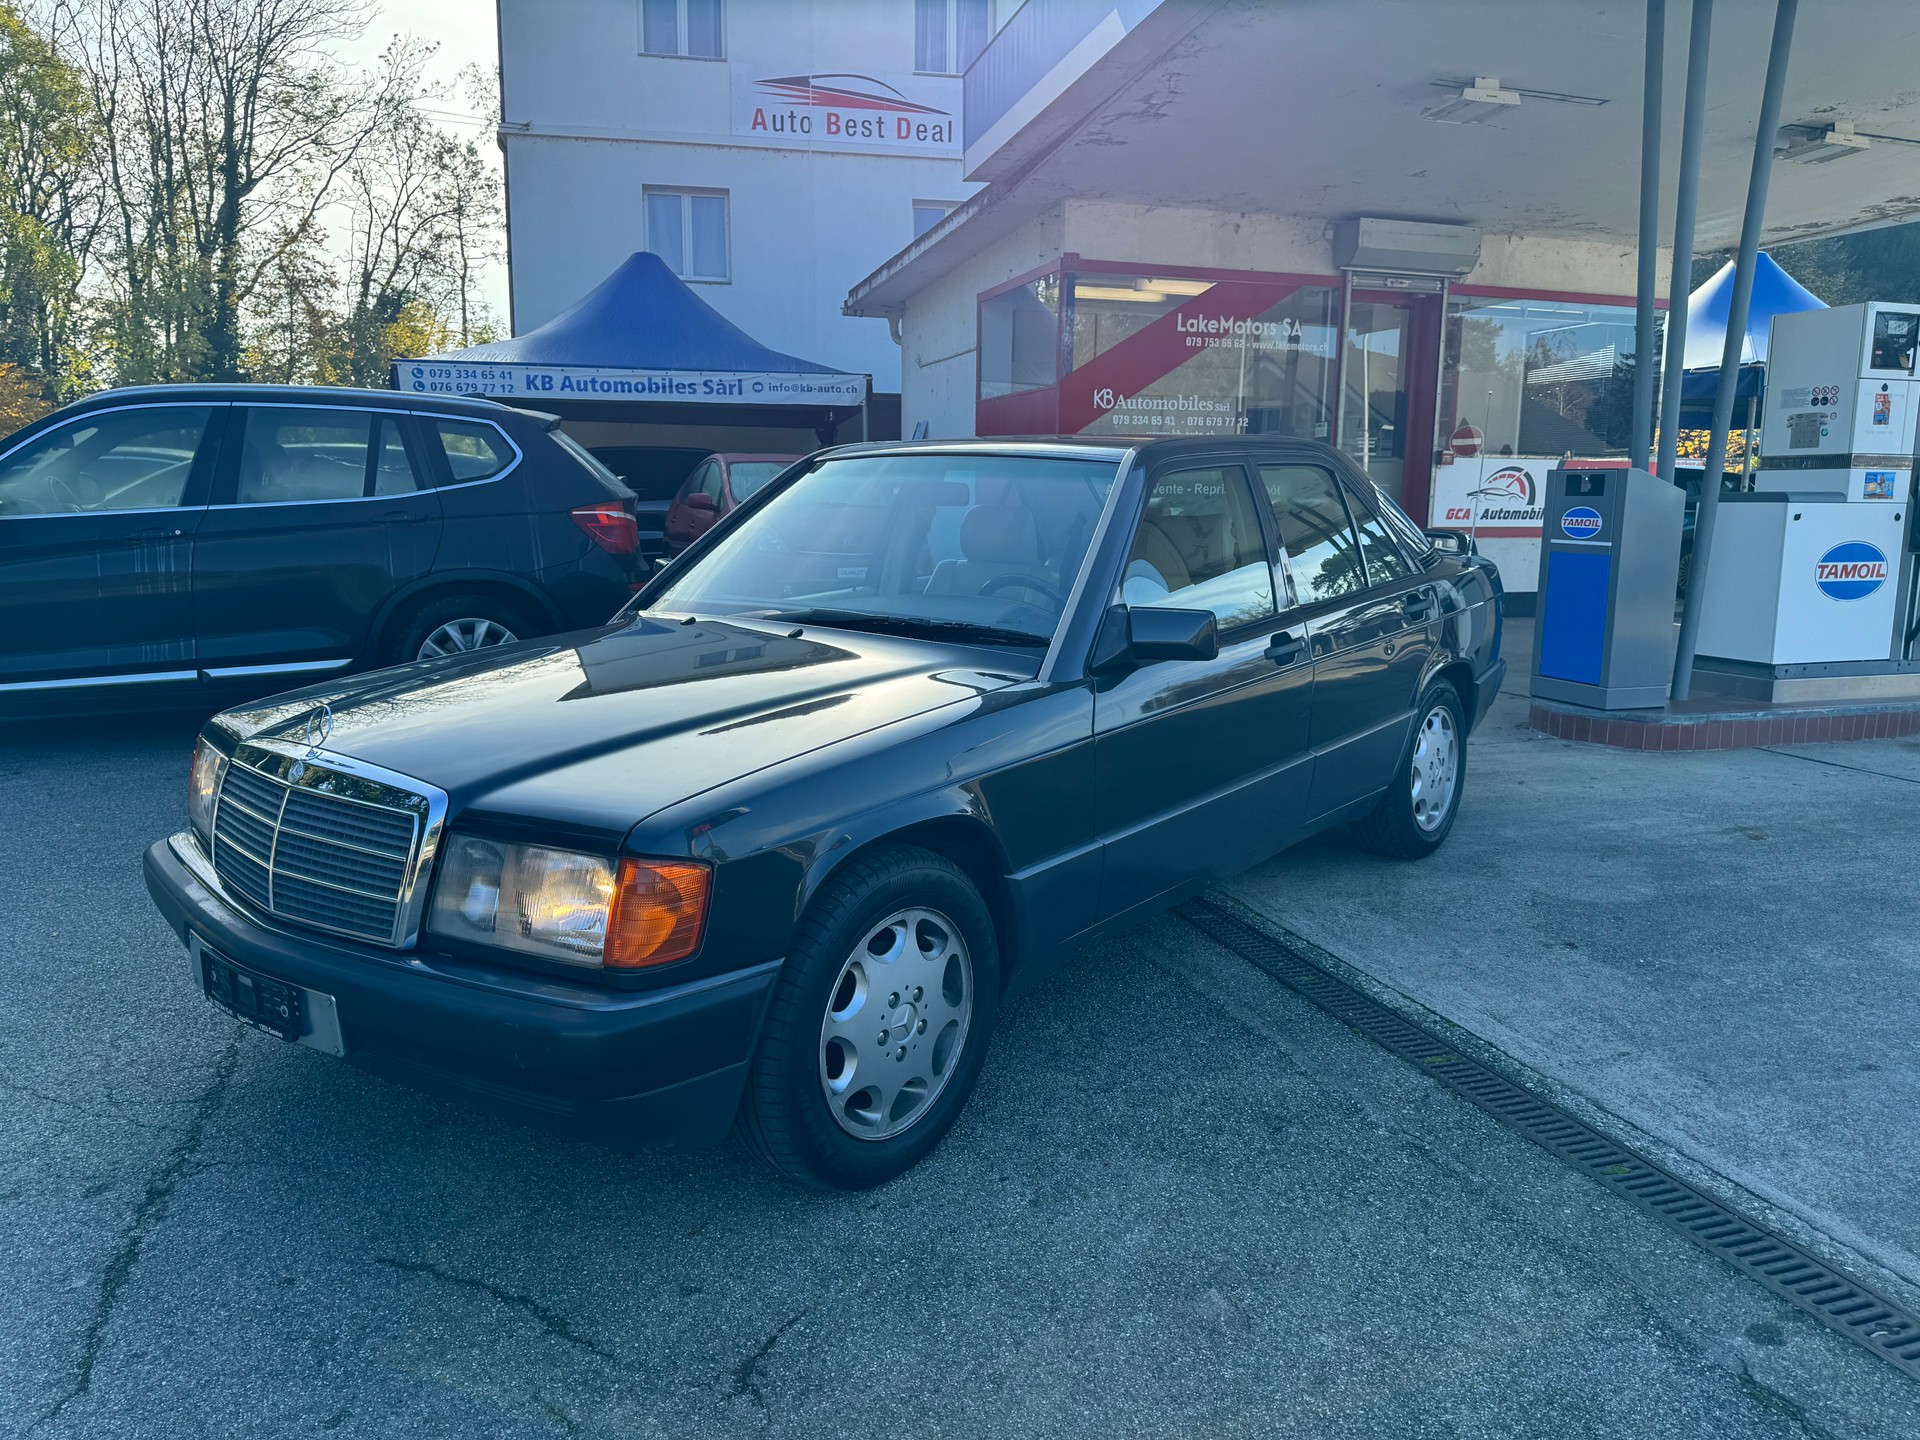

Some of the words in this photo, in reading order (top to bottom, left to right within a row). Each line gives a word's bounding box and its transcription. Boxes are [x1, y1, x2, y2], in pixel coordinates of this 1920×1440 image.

[751, 108, 812, 133] Auto
[826, 112, 885, 138] Best
[896, 117, 952, 143] Deal
[1177, 313, 1276, 336] LakeMotors
[1282, 318, 1302, 337] SA
[1186, 337, 1201, 347] 079
[1204, 338, 1219, 348] 753
[1221, 338, 1232, 348] 69
[1234, 339, 1244, 348] 62
[1906, 347, 1915, 369] 1
[429, 368, 451, 379] 079
[455, 369, 477, 380] 334
[481, 370, 495, 380] 65
[498, 370, 513, 380] 41
[430, 381, 452, 392] 076
[456, 382, 478, 393] 679
[482, 383, 495, 393] 77
[500, 383, 514, 394] 12
[526, 374, 554, 391] KB
[559, 375, 697, 395] Automobiles
[703, 378, 743, 396] Sàrl
[768, 382, 858, 394] info@kb-auto.ch
[1093, 388, 1114, 409] KB
[1114, 394, 1214, 411] Automobiles
[1112, 415, 1129, 425] 079
[1132, 415, 1149, 425] 334
[1151, 416, 1162, 426] 65
[1187, 416, 1203, 426] 076
[1206, 416, 1222, 427] 679
[1225, 417, 1235, 427] 77
[1237, 418, 1249, 427] 12
[1445, 508, 1471, 520] GCA
[1562, 518, 1601, 527] TAMOIL
[1817, 563, 1886, 579] TAMOIL
